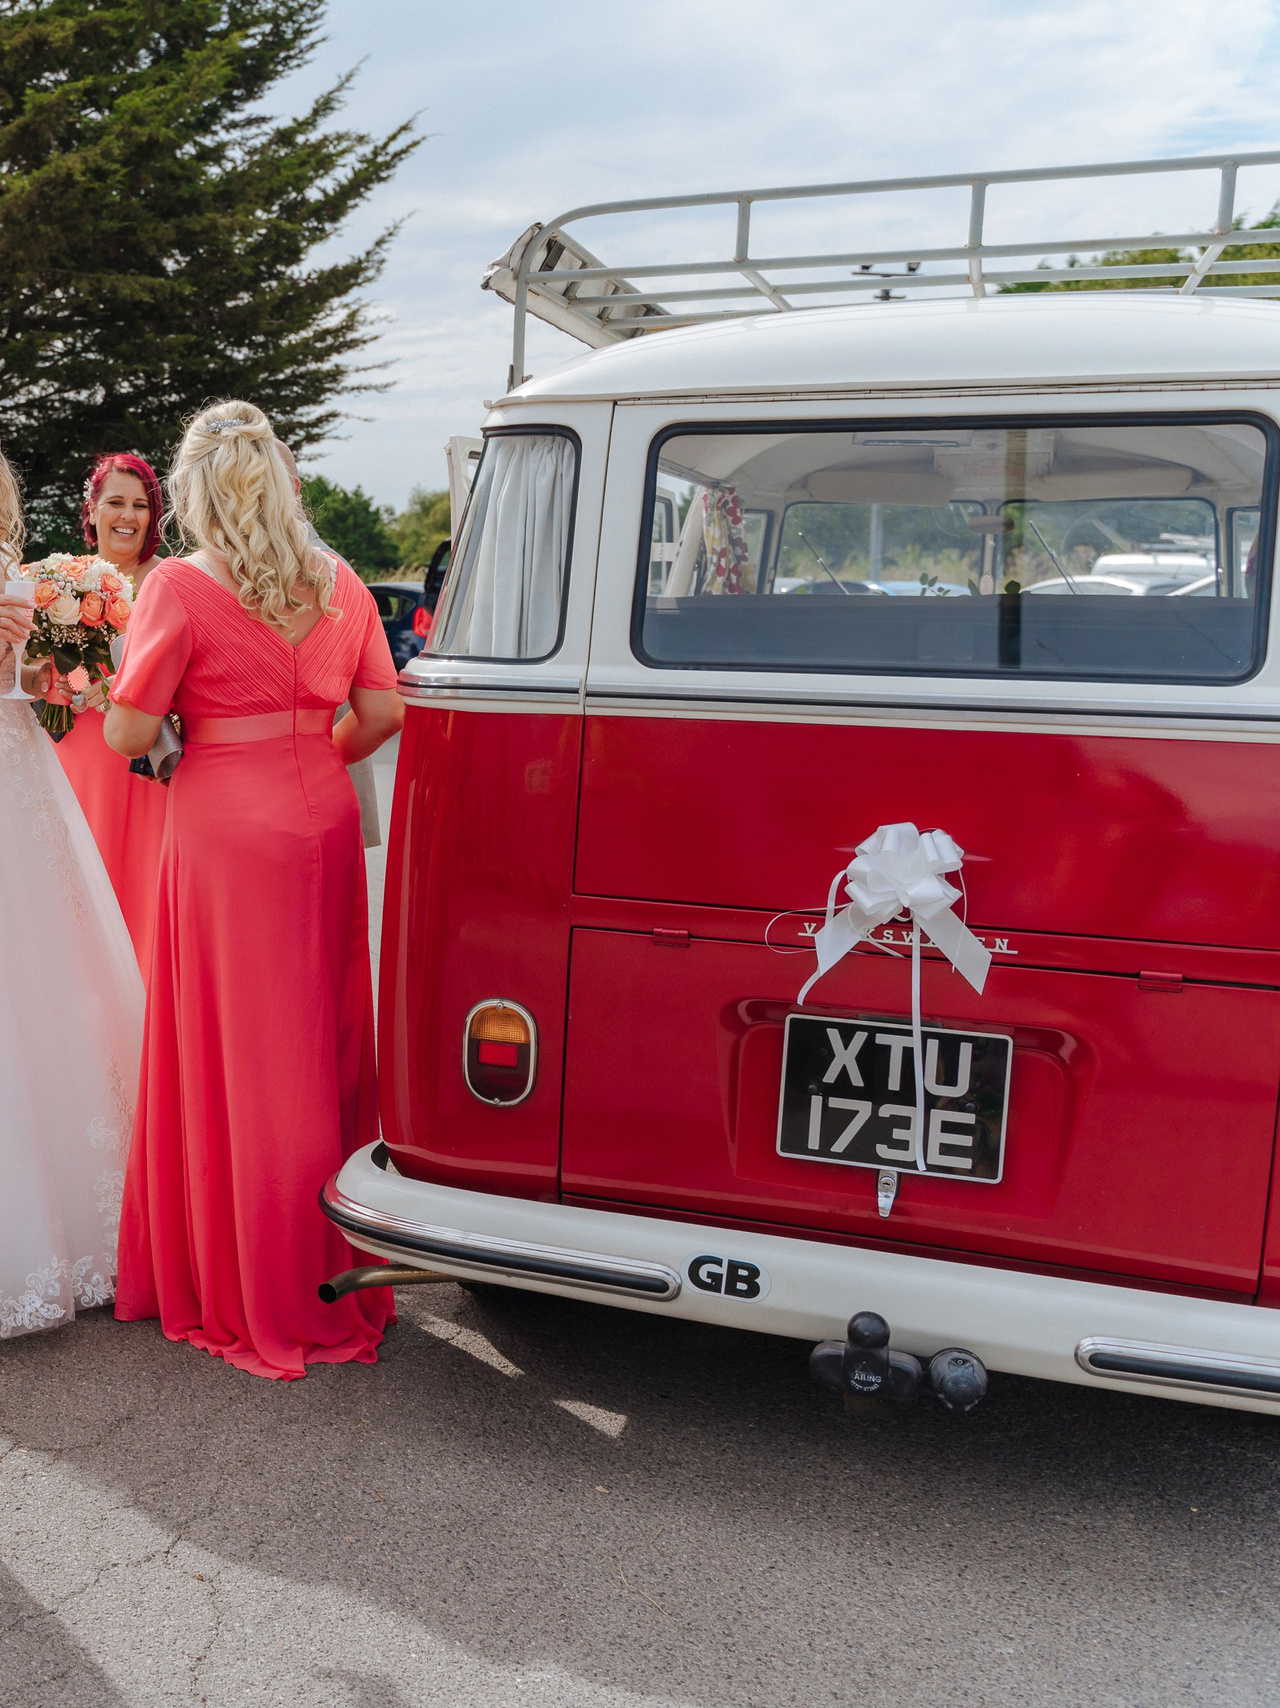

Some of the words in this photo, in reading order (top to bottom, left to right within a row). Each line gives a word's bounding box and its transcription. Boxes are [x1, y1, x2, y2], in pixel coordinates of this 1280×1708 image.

[822, 1027, 973, 1098] XTU
[807, 1094, 976, 1170] 173E
[687, 1254, 761, 1299] GB
